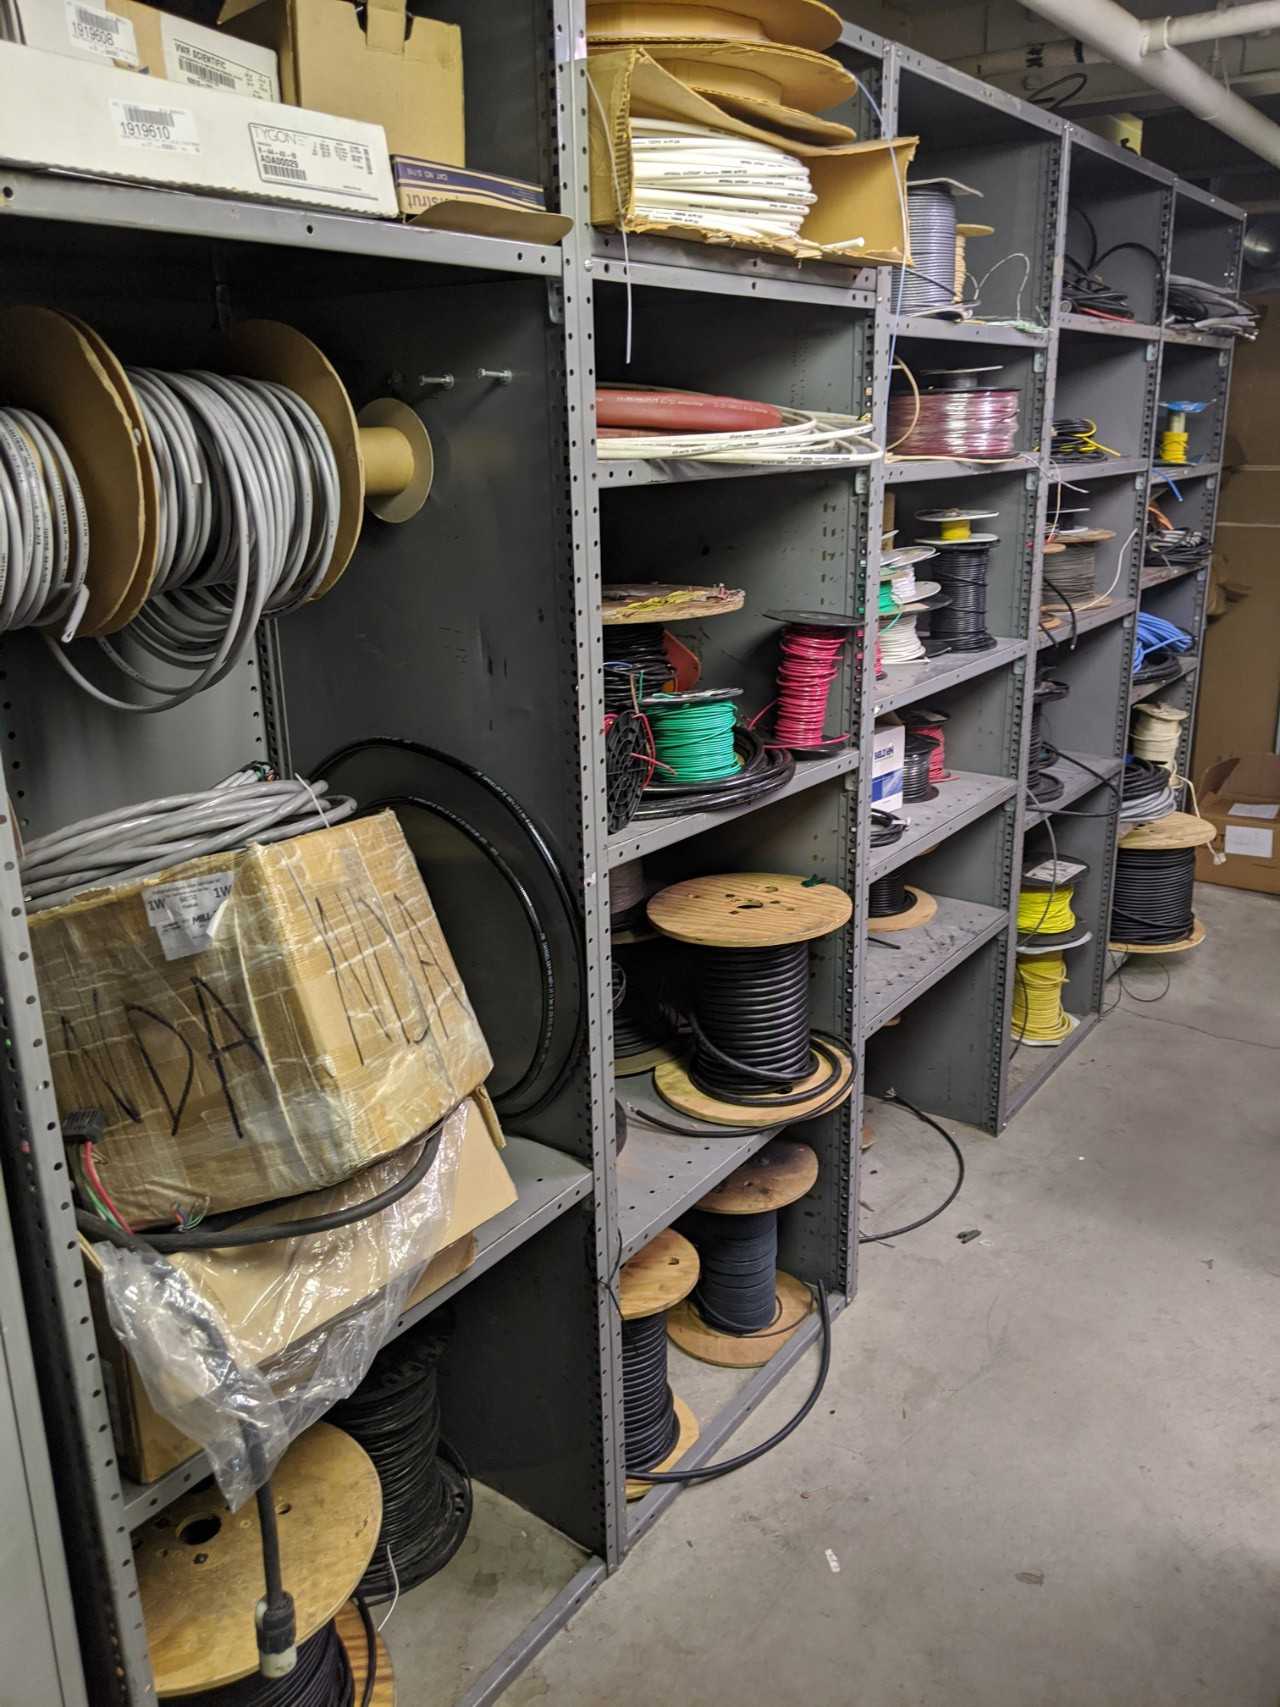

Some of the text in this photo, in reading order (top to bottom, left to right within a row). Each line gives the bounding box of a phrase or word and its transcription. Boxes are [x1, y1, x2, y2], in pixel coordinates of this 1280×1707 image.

[72, 21, 114, 46] 1919608
[193, 50, 227, 69] SCIENTIFIC
[120, 122, 170, 140] 1919610
